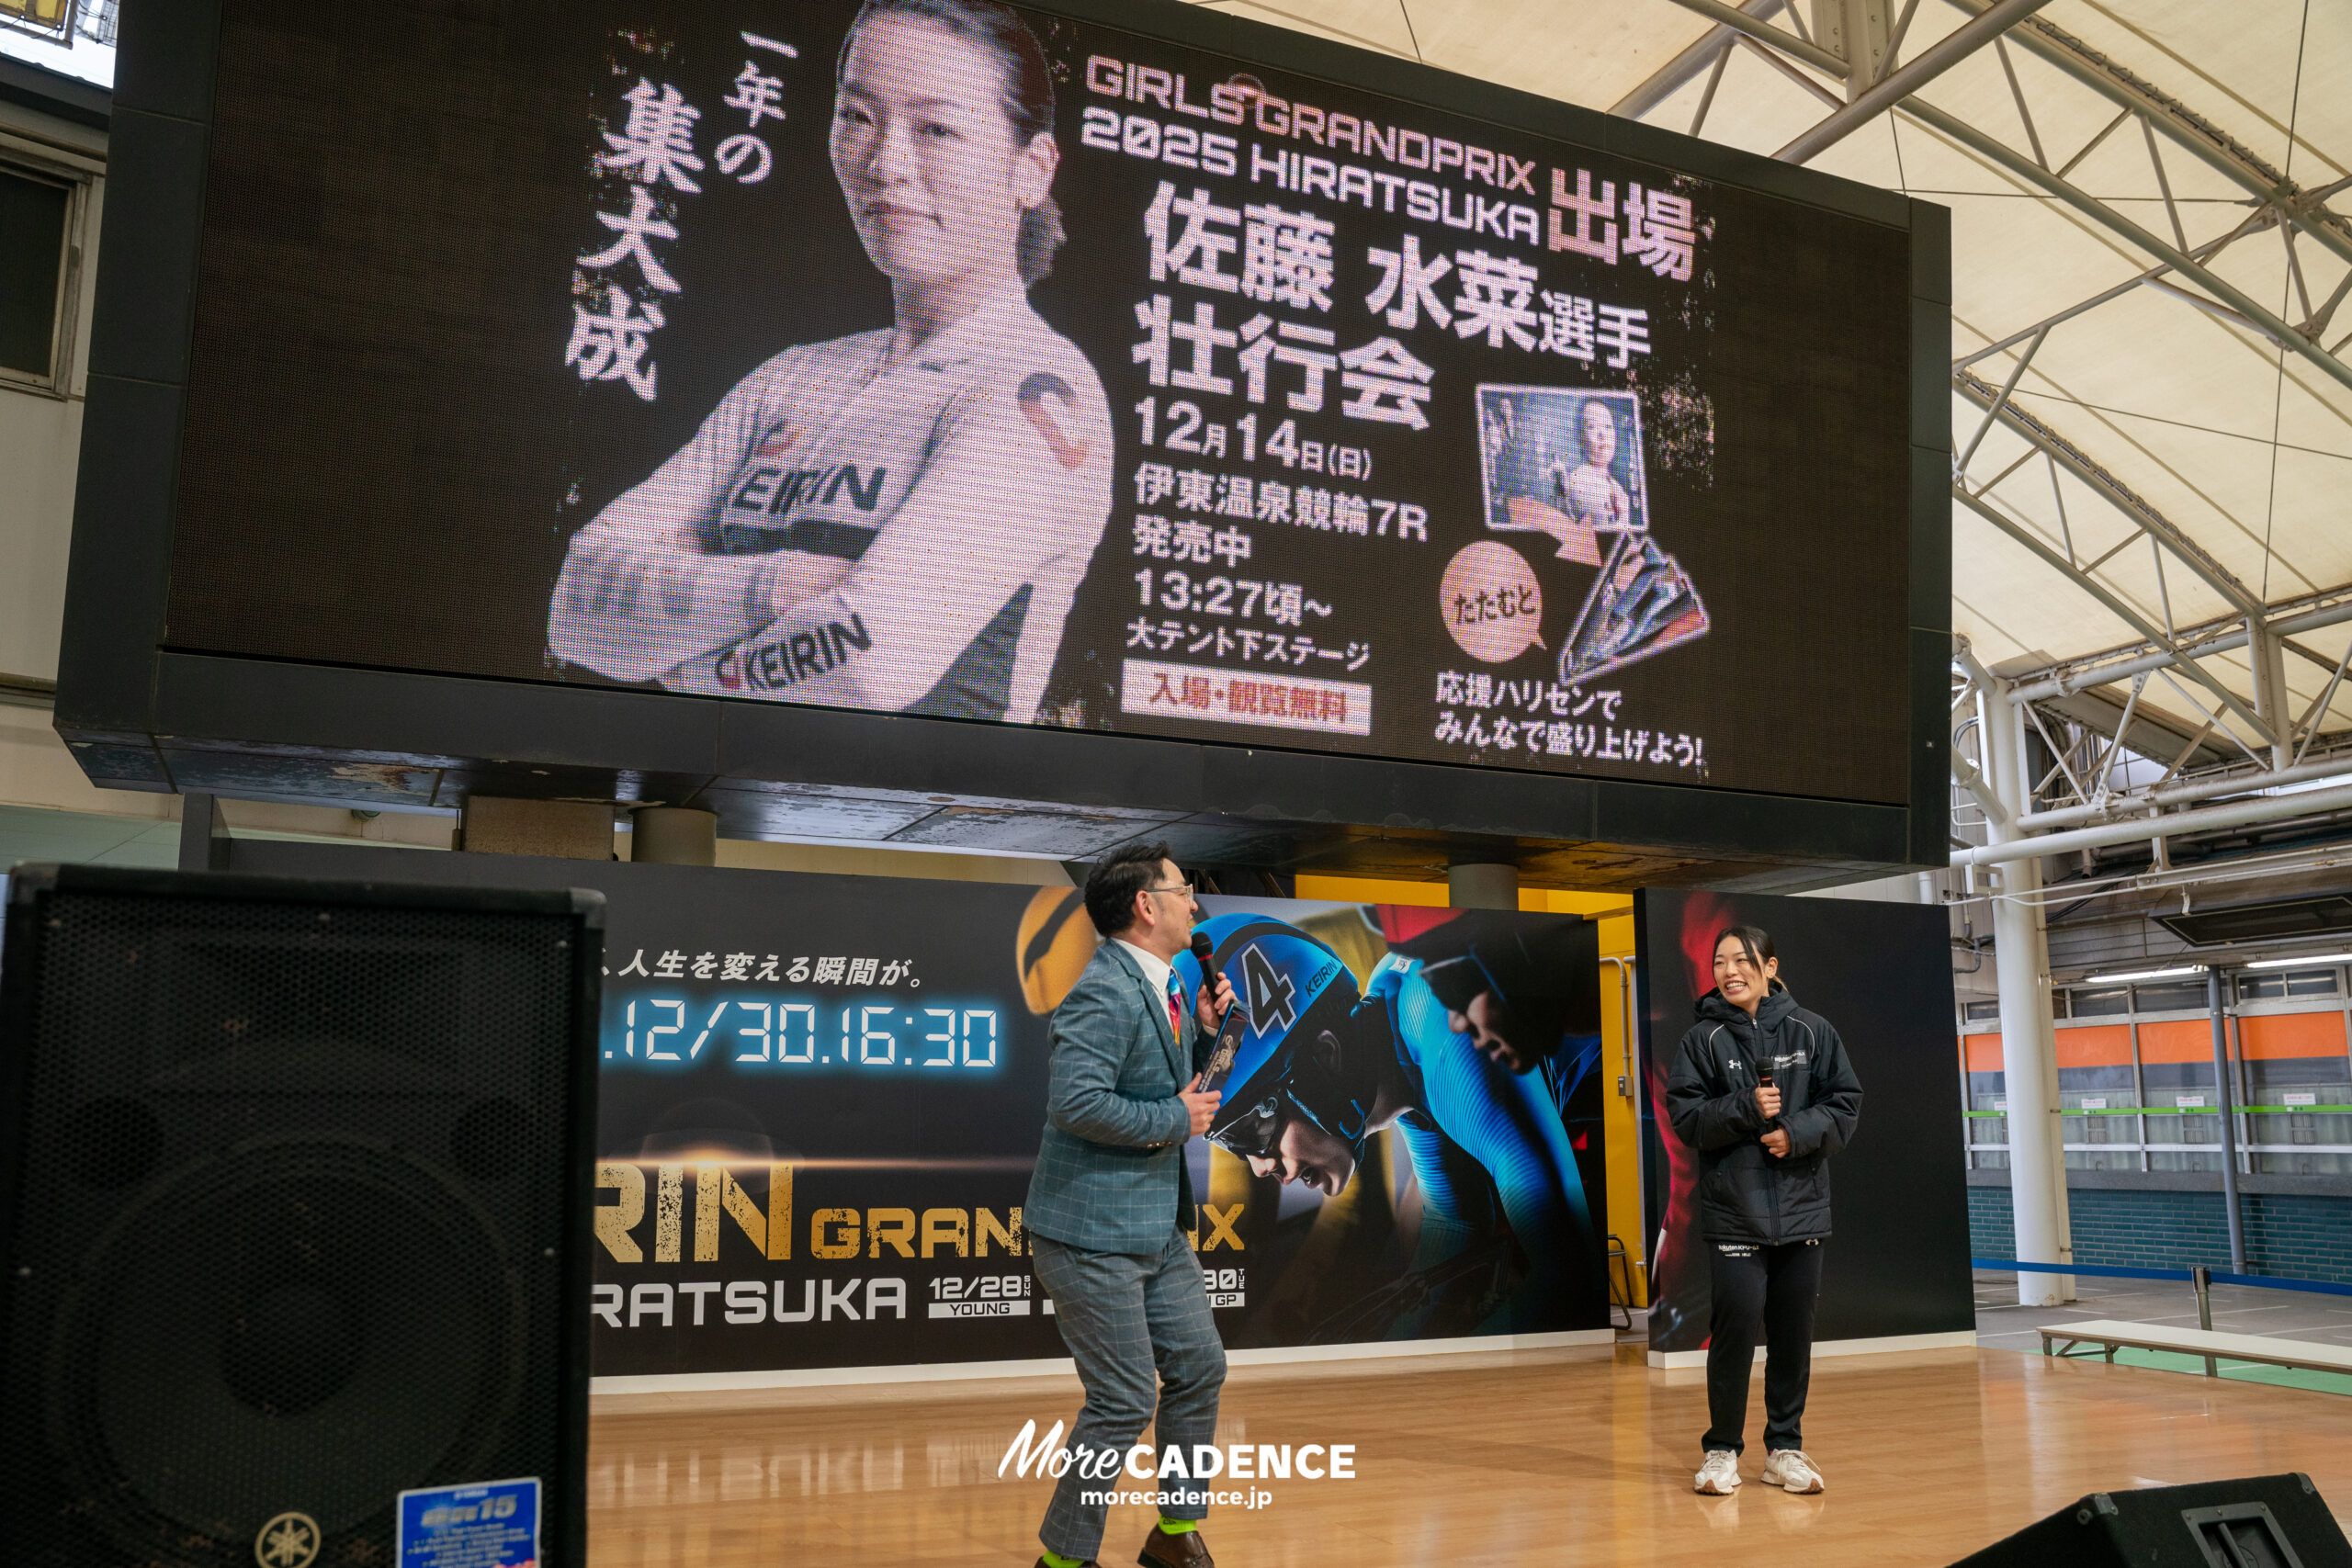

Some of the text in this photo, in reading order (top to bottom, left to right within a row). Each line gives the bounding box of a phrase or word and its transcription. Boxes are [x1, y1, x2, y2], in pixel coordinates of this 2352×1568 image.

[714, 30, 799, 185] 一年の
[1086, 54, 1536, 195] GIRLS GRANDPRIX
[1081, 107, 1540, 245] 2025 HIRATSUKA
[564, 76, 707, 401] 集大成
[1546, 167, 1697, 282] 出場
[1143, 180, 1651, 368] 佐藤 水菜選手
[1132, 295, 1435, 431] 壮行会
[1134, 461, 1429, 542] 伊東温泉競輪7R
[1133, 514, 1252, 568] 発売中
[1453, 590, 1537, 625] たたむと
[1126, 616, 1370, 671] 大テント下ステージ
[1148, 671, 1348, 724] 入場・観覧無料
[1435, 671, 1622, 721] 応援ハリセンで
[1435, 710, 1704, 767] みんなで盛り上げよう!
[1242, 943, 1296, 1039] 4
[1305, 959, 1338, 998] KEIRIN
[929, 1275, 1022, 1300] 12/28
[949, 1303, 1011, 1316] YOUNG
[1216, 1293, 1237, 1307] GP
